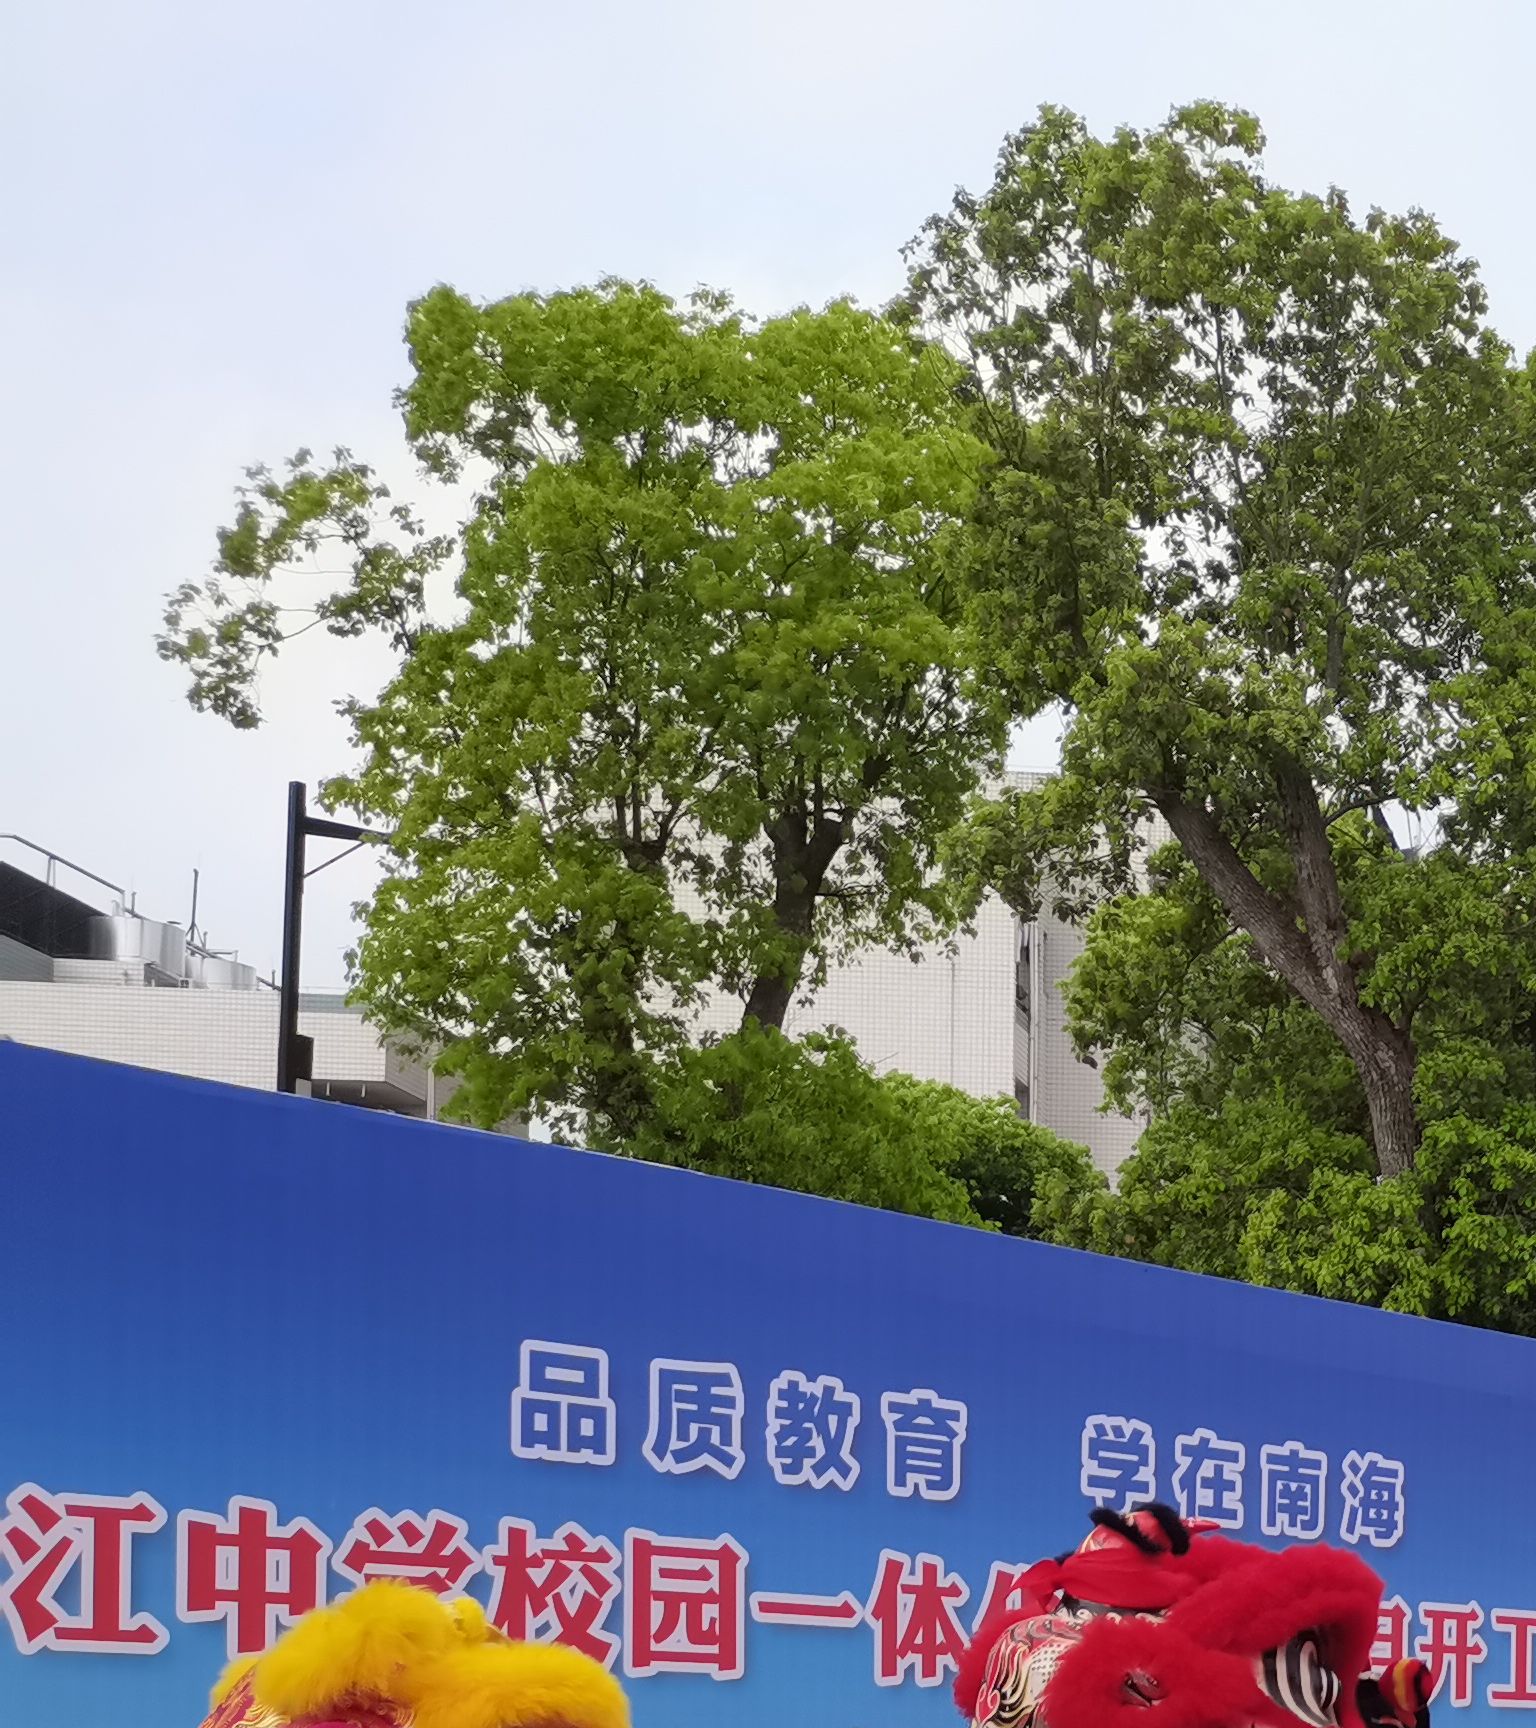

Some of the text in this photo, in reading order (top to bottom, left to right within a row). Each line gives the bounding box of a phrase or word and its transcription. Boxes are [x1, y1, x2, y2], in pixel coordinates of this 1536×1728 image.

[511, 1338, 1405, 1548] 品质教育 学在南海
